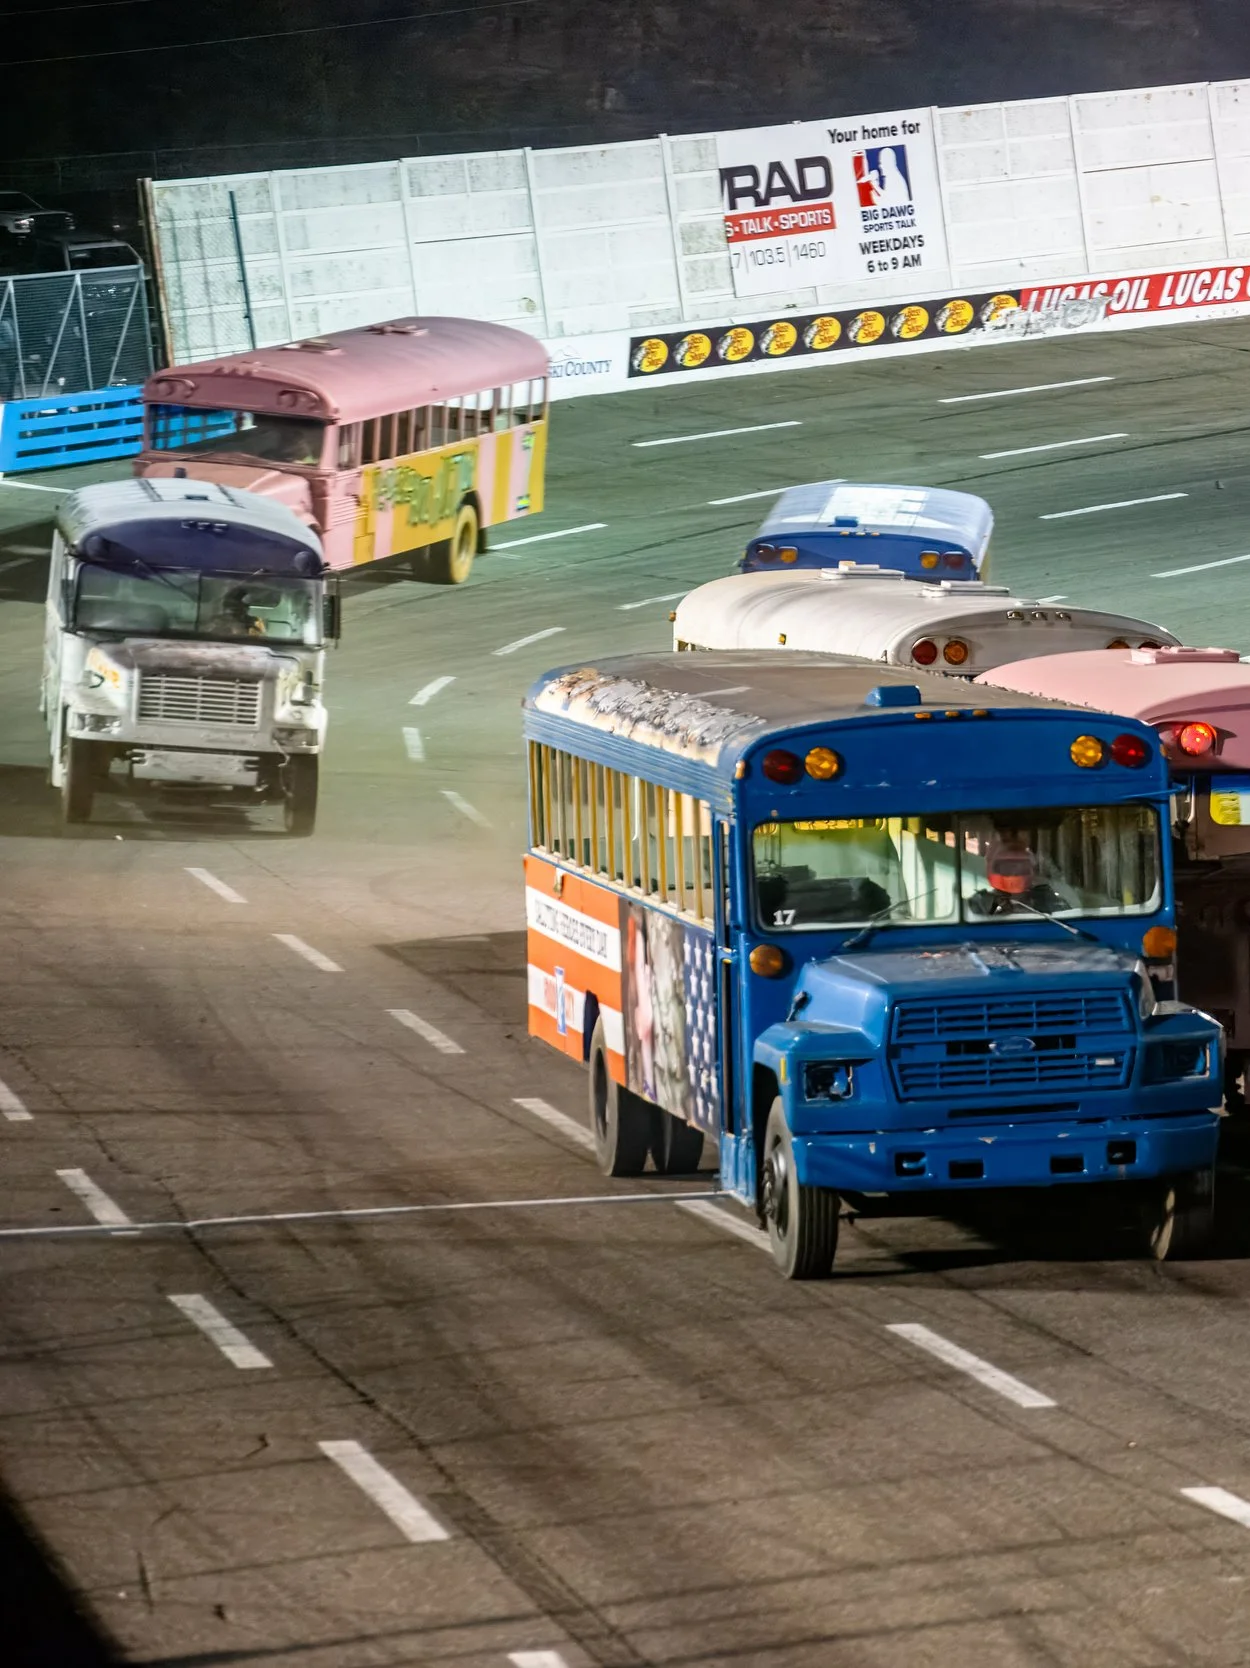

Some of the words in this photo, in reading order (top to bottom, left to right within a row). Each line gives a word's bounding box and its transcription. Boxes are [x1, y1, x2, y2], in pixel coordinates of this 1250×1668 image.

[828, 128, 858, 144] Your
[861, 125, 899, 140] home
[901, 120, 921, 135] for
[780, 209, 832, 230] SPORTS
[861, 210, 880, 222] BIG
[881, 204, 915, 219] DAWG
[863, 221, 894, 233] SPORTS
[896, 218, 917, 230] TALK
[792, 241, 826, 261] 1460
[859, 234, 925, 255] WEEKDAYS
[867, 260, 876, 273] 6
[877, 261, 888, 272] to
[891, 257, 899, 270] 9
[902, 254, 922, 268] AM
[1109, 278, 1151, 312] OIL
[1157, 267, 1244, 307] LUCAS
[773, 909, 796, 926] 17
